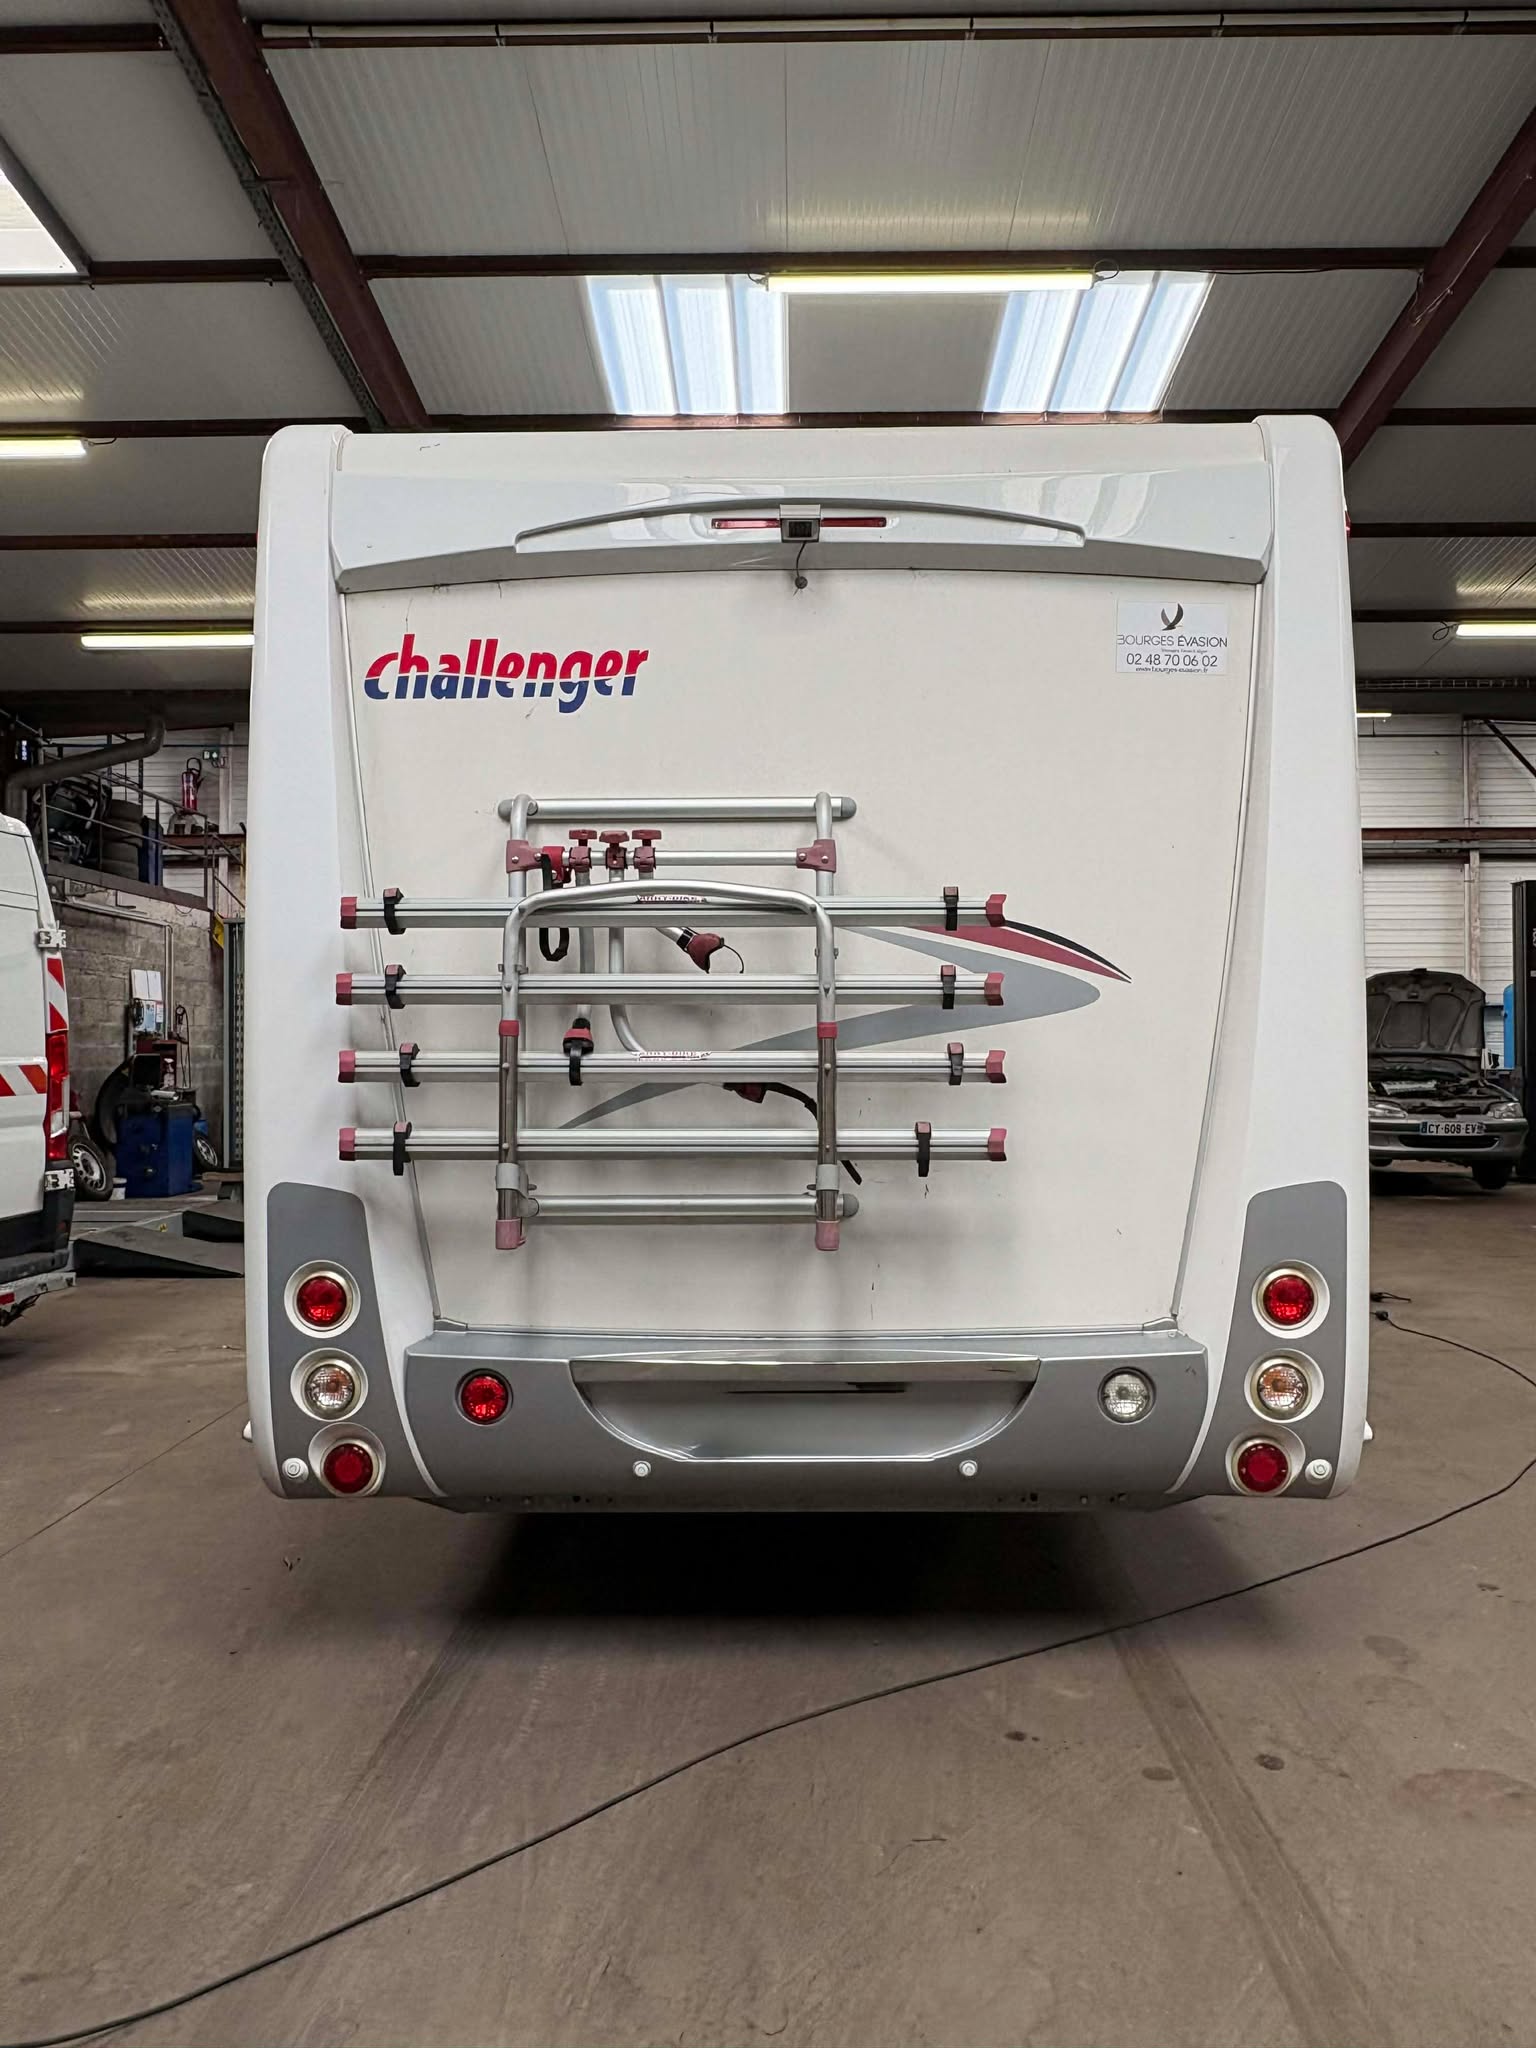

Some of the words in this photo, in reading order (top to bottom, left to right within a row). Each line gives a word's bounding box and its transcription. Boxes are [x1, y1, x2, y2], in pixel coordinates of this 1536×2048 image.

[1117, 634, 1174, 646] BOURGES
[1177, 634, 1228, 648] ÉVASION
[1126, 653, 1142, 665] 02
[1145, 653, 1161, 666] 48
[1164, 654, 1180, 666] 70
[1183, 655, 1199, 666] 06
[1202, 655, 1218, 667] 02
[364, 633, 650, 714] challenger
